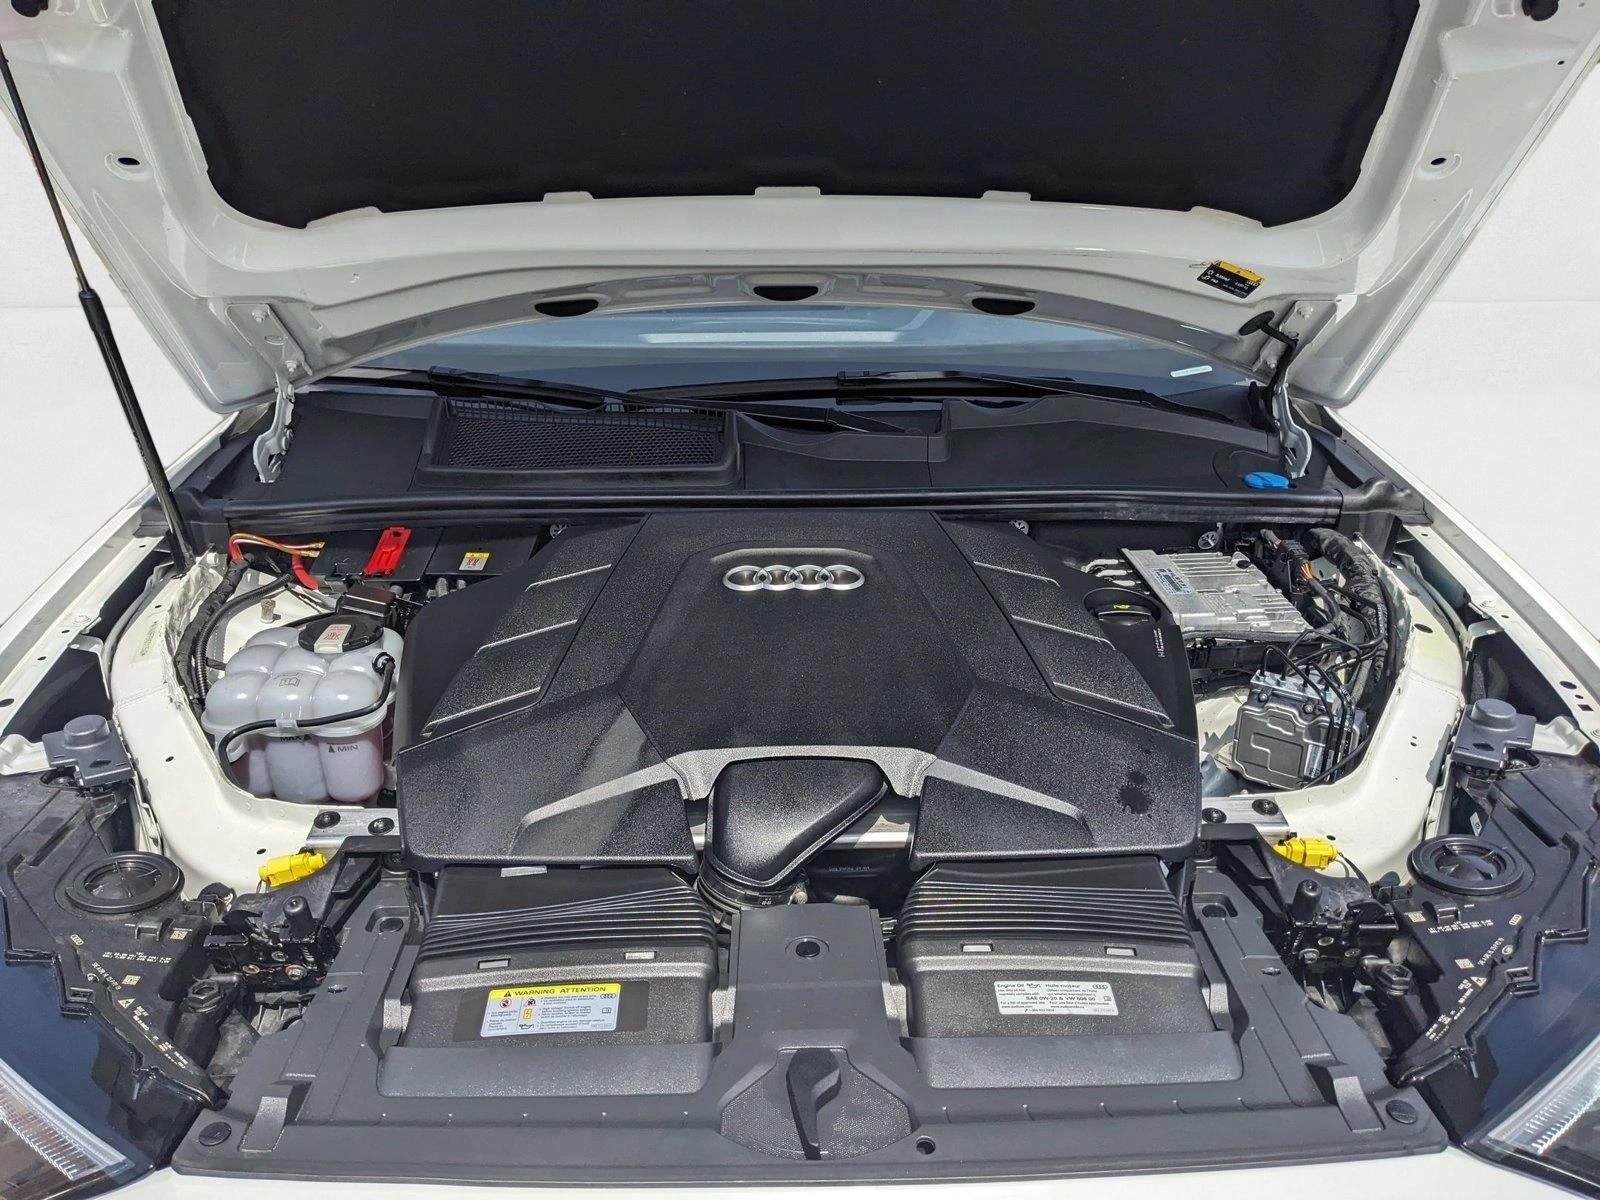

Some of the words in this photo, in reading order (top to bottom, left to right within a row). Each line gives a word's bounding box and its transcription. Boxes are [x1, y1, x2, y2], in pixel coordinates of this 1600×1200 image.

[337, 744, 359, 752] MIN
[514, 988, 556, 996] WARNING
[559, 986, 607, 994] ATTENTION
